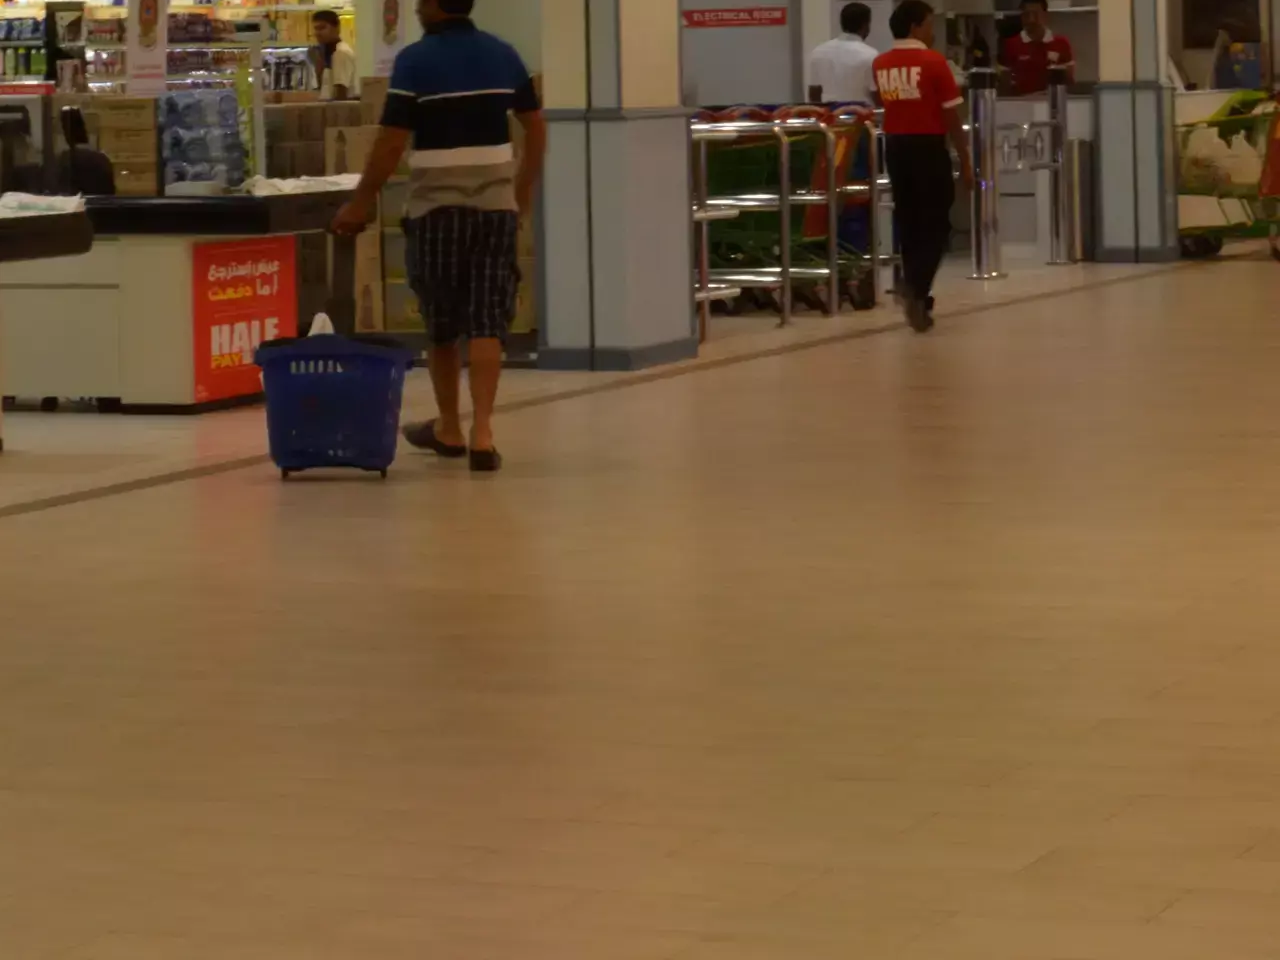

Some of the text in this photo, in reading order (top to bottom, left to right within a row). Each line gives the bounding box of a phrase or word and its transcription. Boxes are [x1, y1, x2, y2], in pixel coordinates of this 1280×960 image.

[691, 11, 752, 21] ELECTRICAL
[876, 66, 922, 93] HALF
[210, 317, 280, 357] HALF
